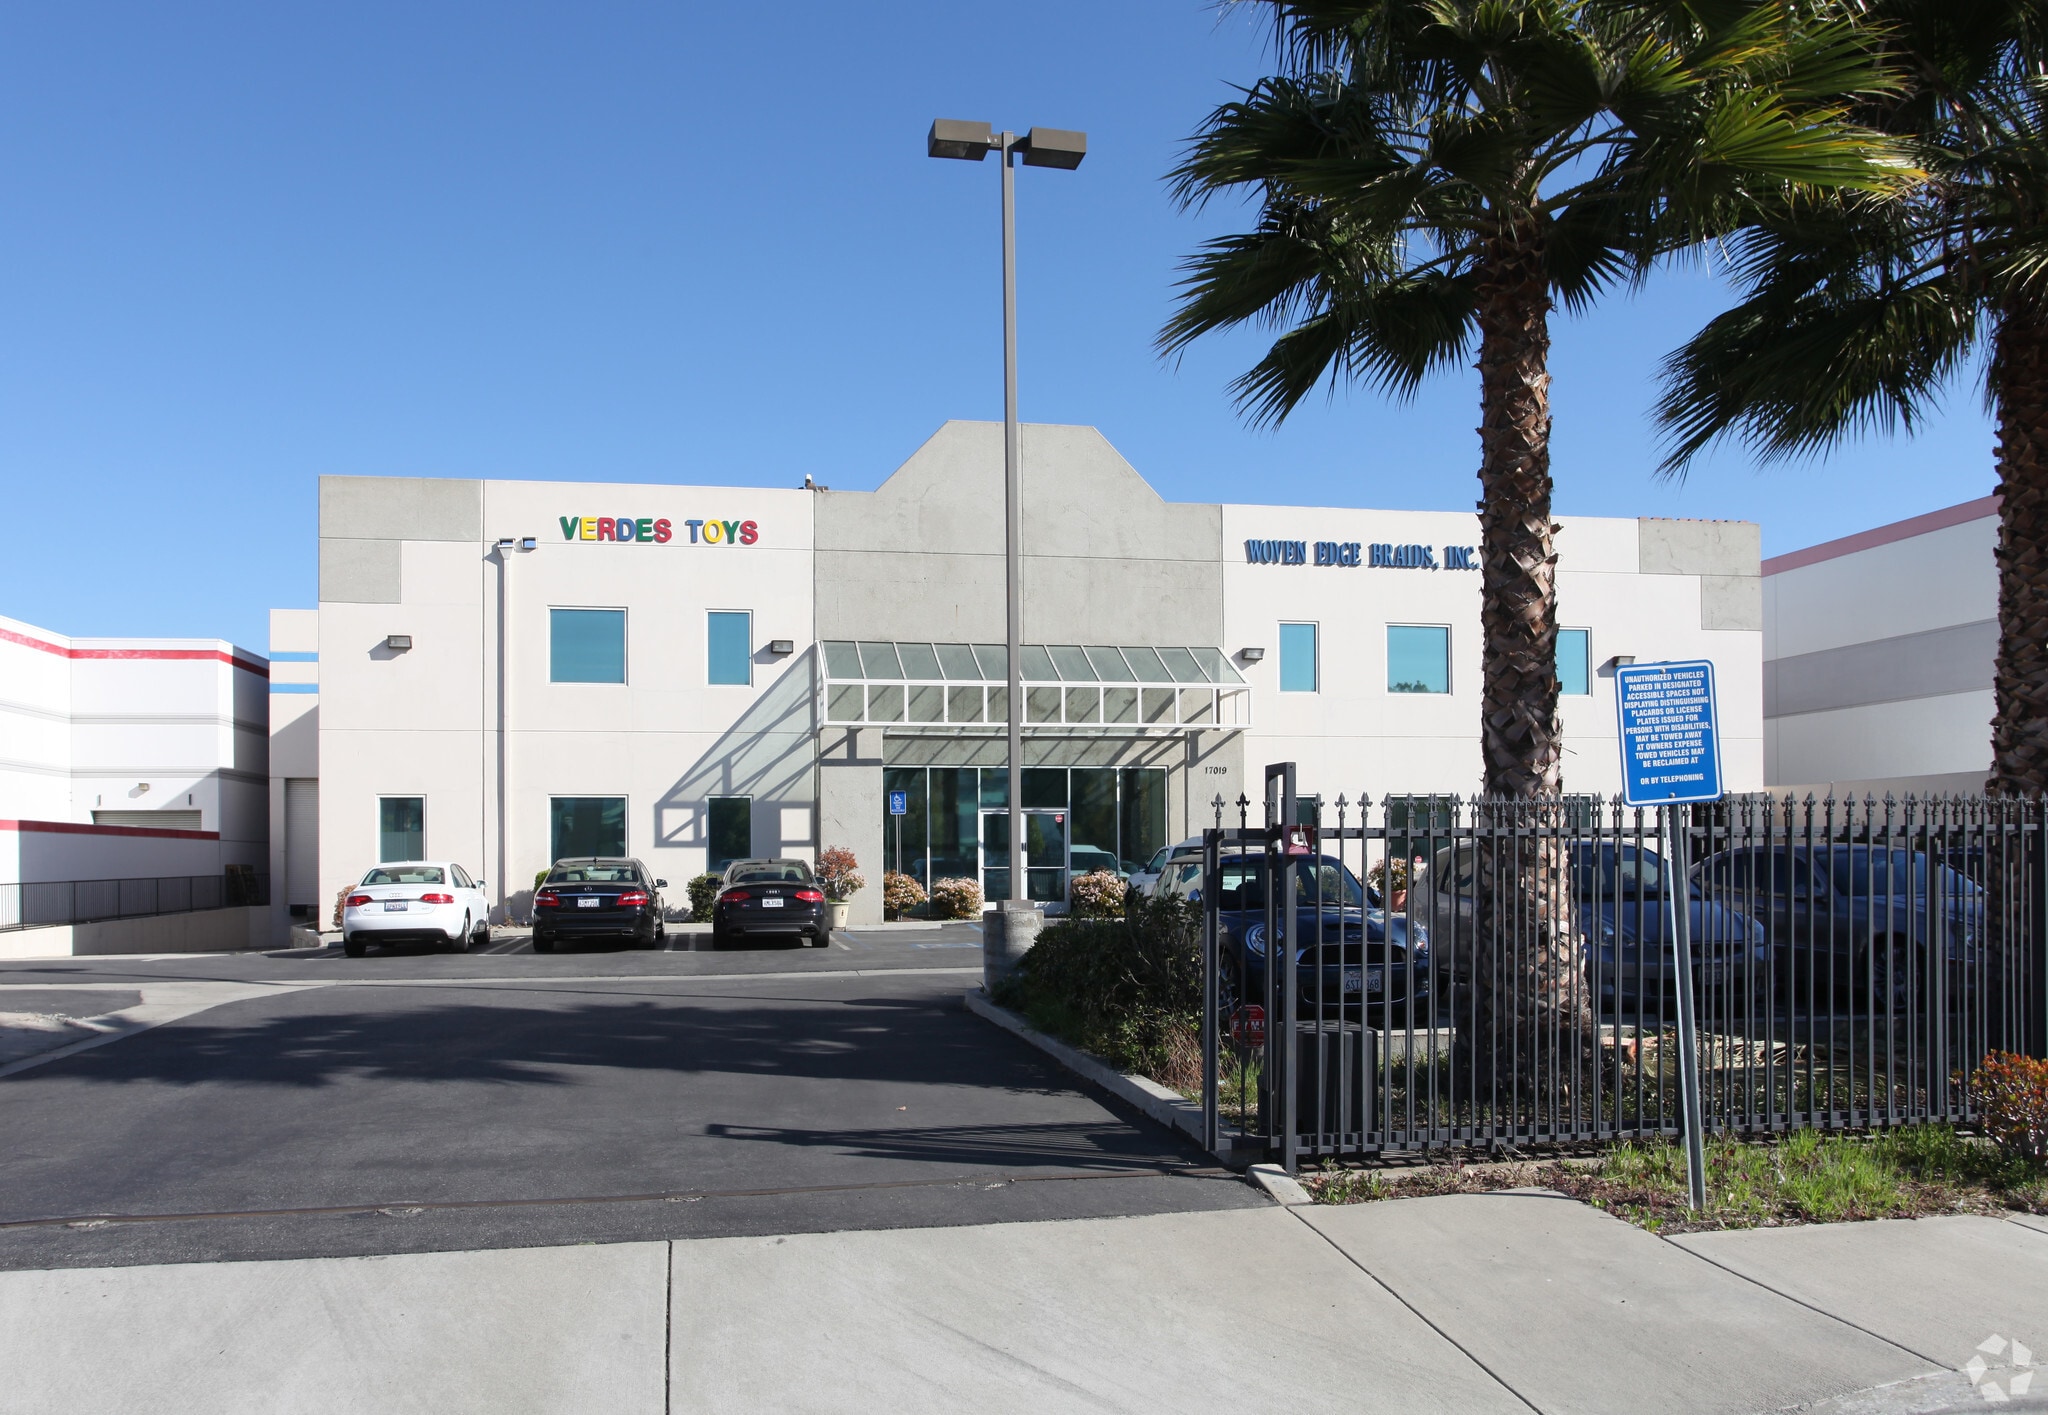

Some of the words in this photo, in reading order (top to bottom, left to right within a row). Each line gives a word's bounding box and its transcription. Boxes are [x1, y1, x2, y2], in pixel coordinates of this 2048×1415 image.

[559, 516, 672, 543] VERDES
[685, 519, 759, 545] TOYS
[1243, 539, 1307, 565] WOVEN
[1313, 541, 1362, 567] EDGE
[1368, 543, 1439, 573] BRAIDS,
[1442, 545, 1480, 571] INC.
[1625, 673, 1672, 683] UNAUTHORIZED
[1673, 671, 1704, 680] VEHICLES
[1663, 680, 1701, 689] DESIGNATED
[1627, 691, 1664, 700] ACCESSIBLE
[1666, 689, 1690, 697] SPACES
[1624, 701, 1658, 709] DISPLAYING
[1660, 697, 1709, 706] DISTINGUISHING
[1632, 709, 1664, 717] PLACARDS
[1676, 705, 1702, 713] LICENSE
[1637, 717, 1660, 725] PLATES
[1661, 715, 1683, 723] ISSUED
[1671, 722, 1711, 731] DISABILITIES,
[1661, 732, 1682, 740] TOWED
[1685, 731, 1702, 739] AWAY
[1646, 742, 1672, 750] OWNERS
[1674, 740, 1702, 748] EXPENSE
[1653, 758, 1689, 767] RECLAIMED
[1660, 773, 1704, 783] TELEPHONING
